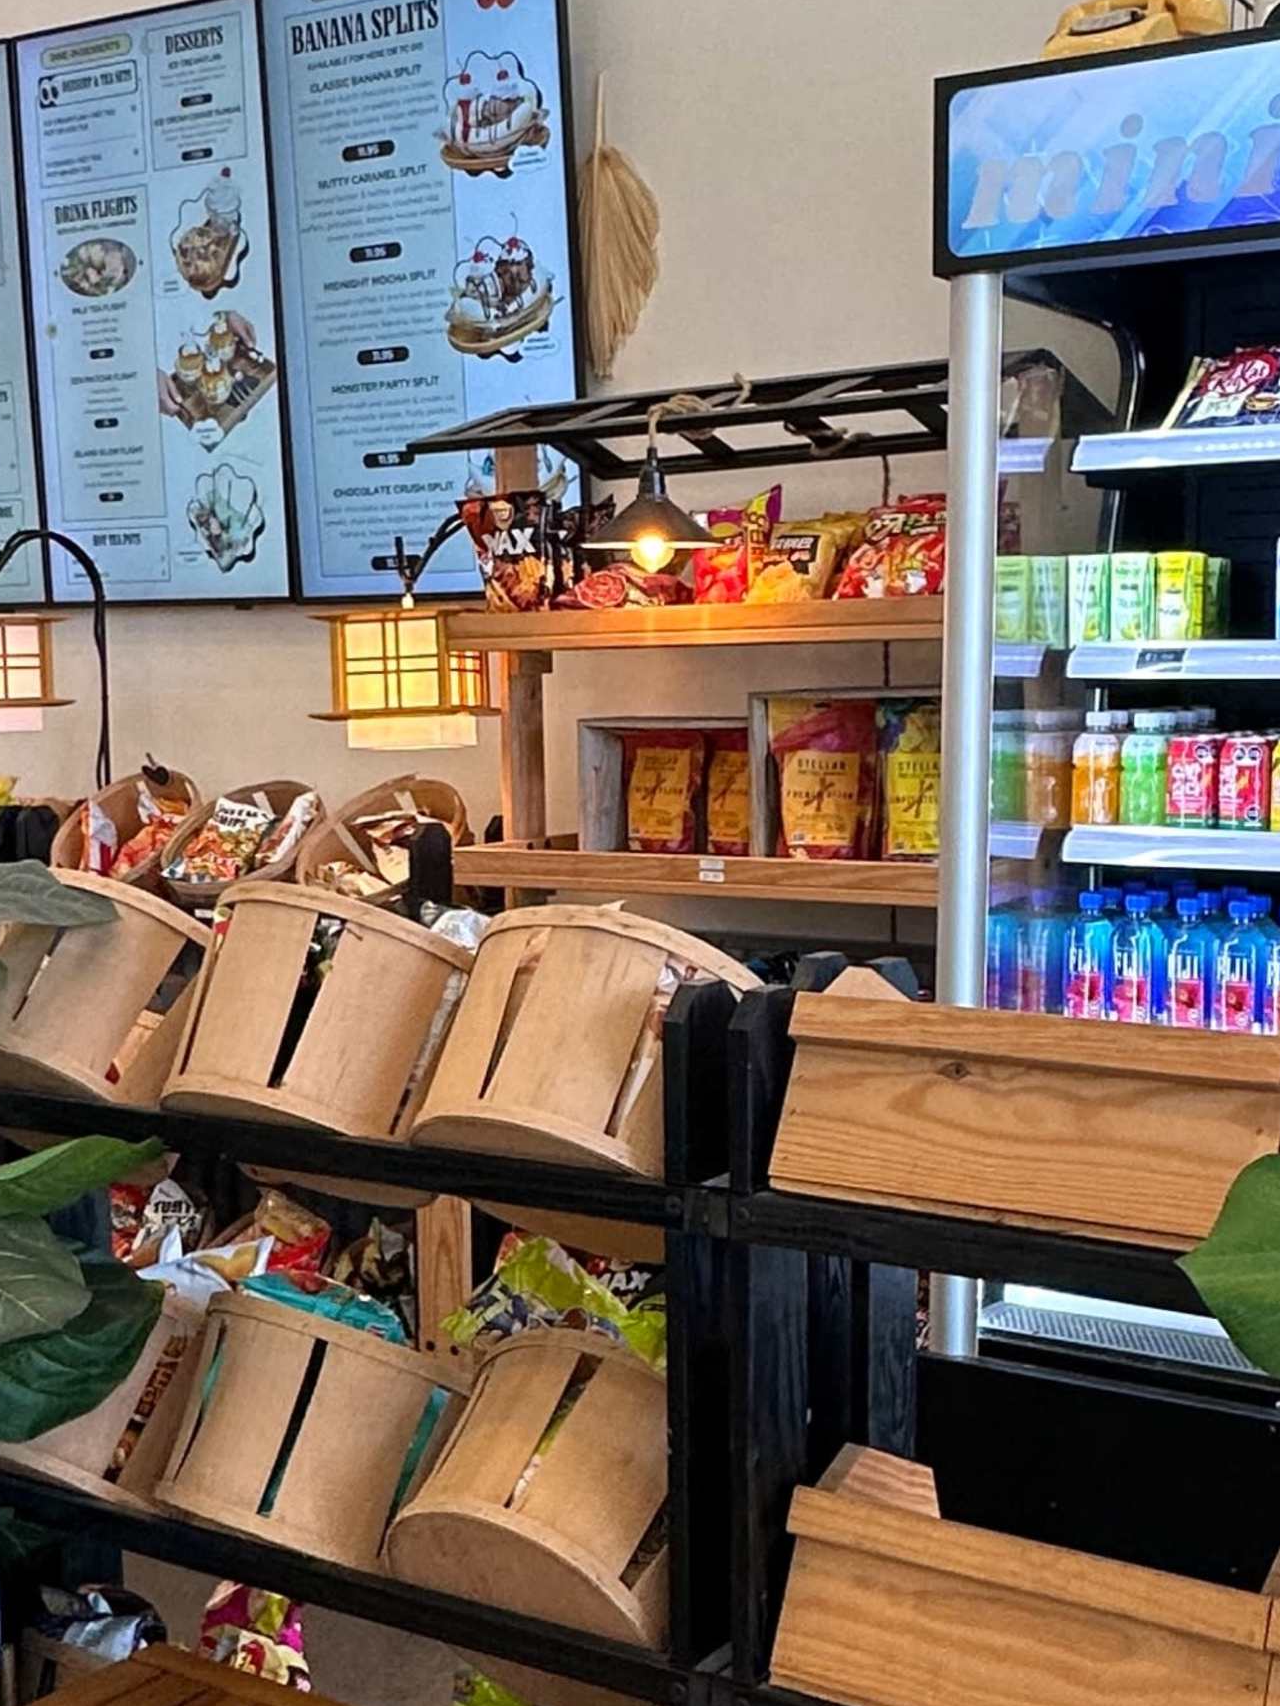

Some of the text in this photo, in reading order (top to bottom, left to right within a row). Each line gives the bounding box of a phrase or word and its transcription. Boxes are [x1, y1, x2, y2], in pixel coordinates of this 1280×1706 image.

[165, 25, 223, 55] DESSERTS
[291, 12, 368, 55] BANANA
[309, 63, 422, 93] CLASSIC BANANA SPLIT
[319, 164, 427, 189] NUTTY CARAMEL SPLIT
[92, 195, 138, 219] FLIGHTS
[371, 272, 407, 287] MOCHA
[409, 269, 437, 281] SPLIT
[331, 375, 440, 394] MONSTER PARTY SPLIT
[333, 480, 455, 498] CHOCOLATE CRUSH SPLIT
